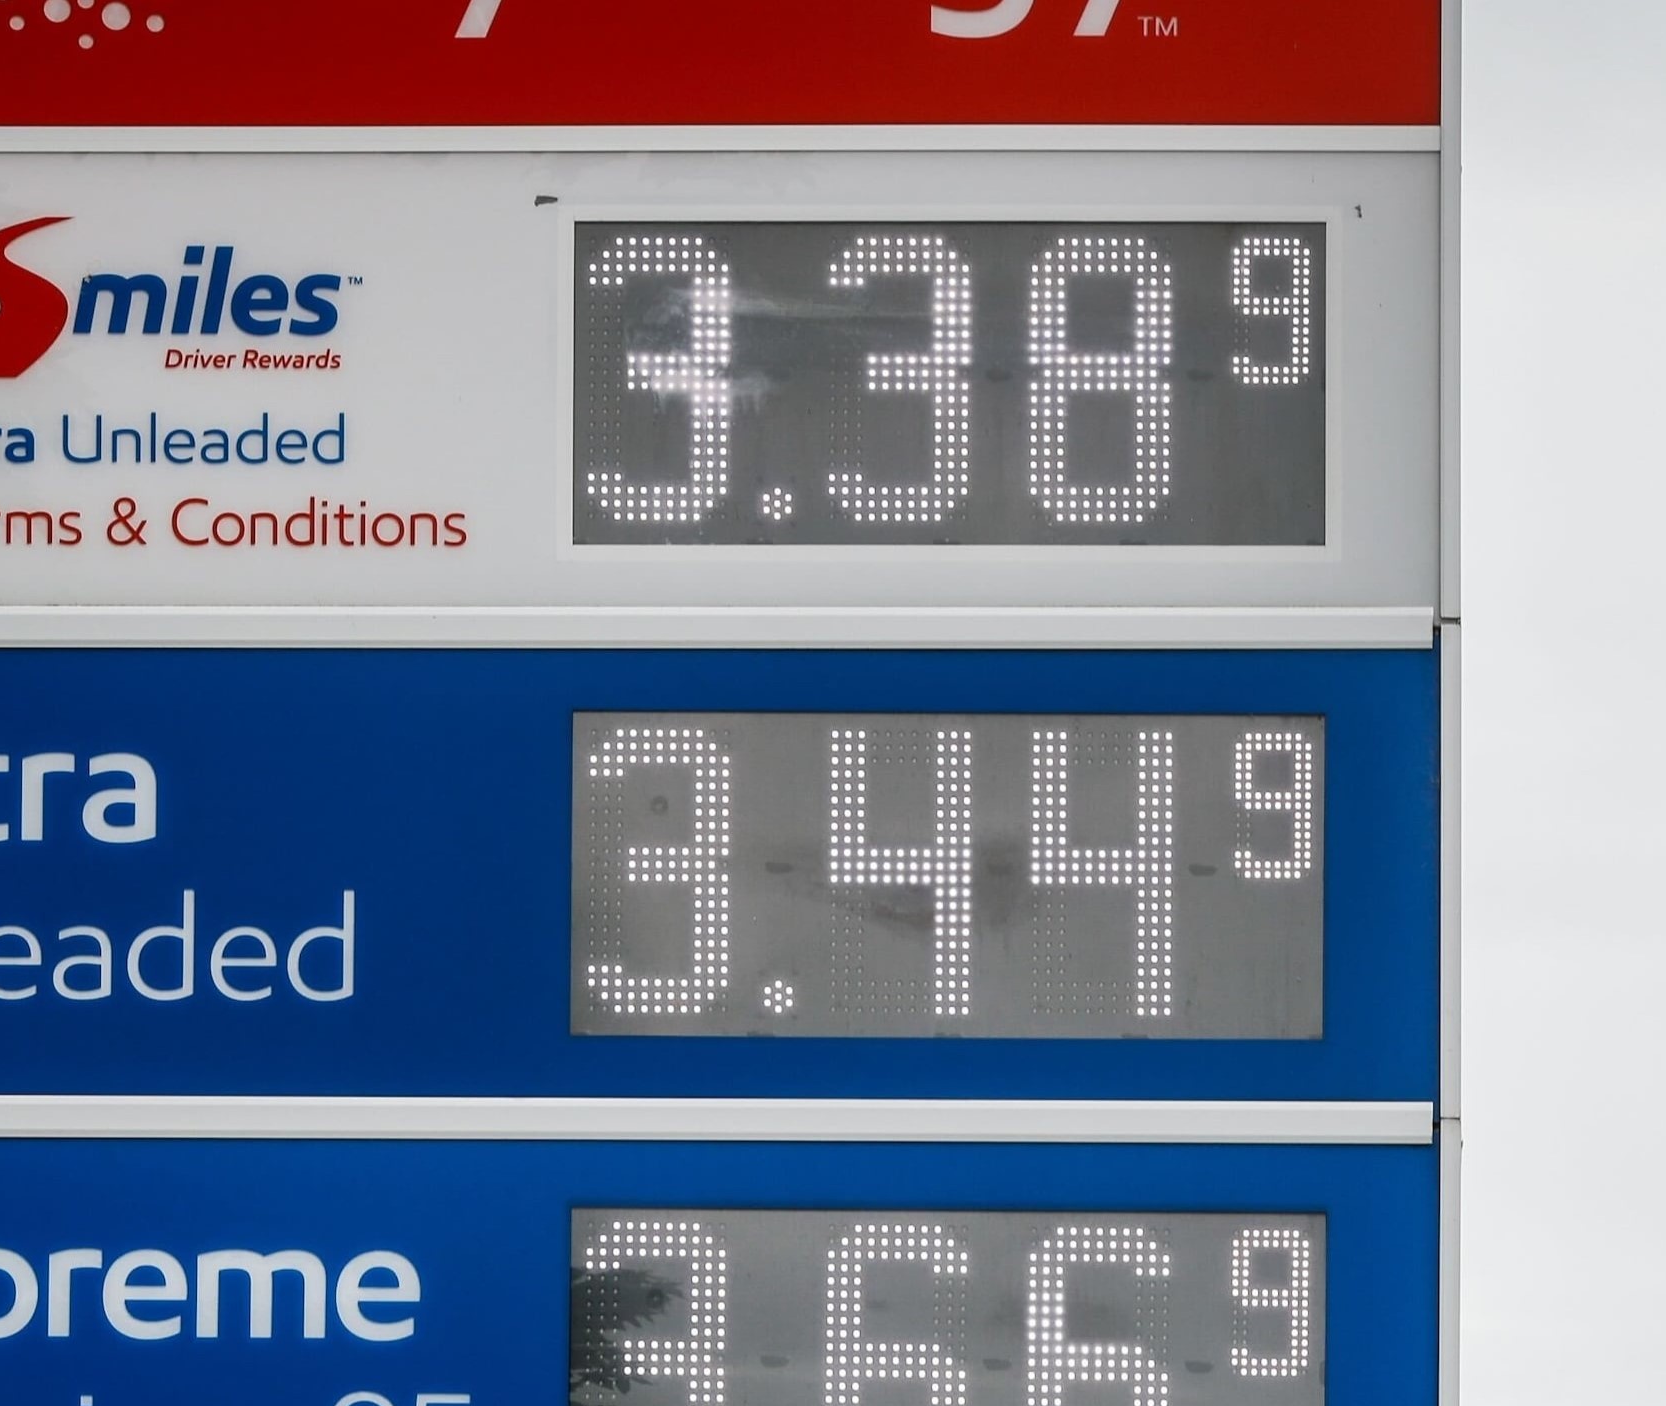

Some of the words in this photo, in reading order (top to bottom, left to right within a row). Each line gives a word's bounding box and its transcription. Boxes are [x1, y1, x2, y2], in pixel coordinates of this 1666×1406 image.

[165, 349, 236, 369] Driver
[242, 349, 341, 369] Rewards
[61, 412, 347, 465] Unleaded
[106, 497, 148, 547] &
[170, 496, 468, 547] Conditions
